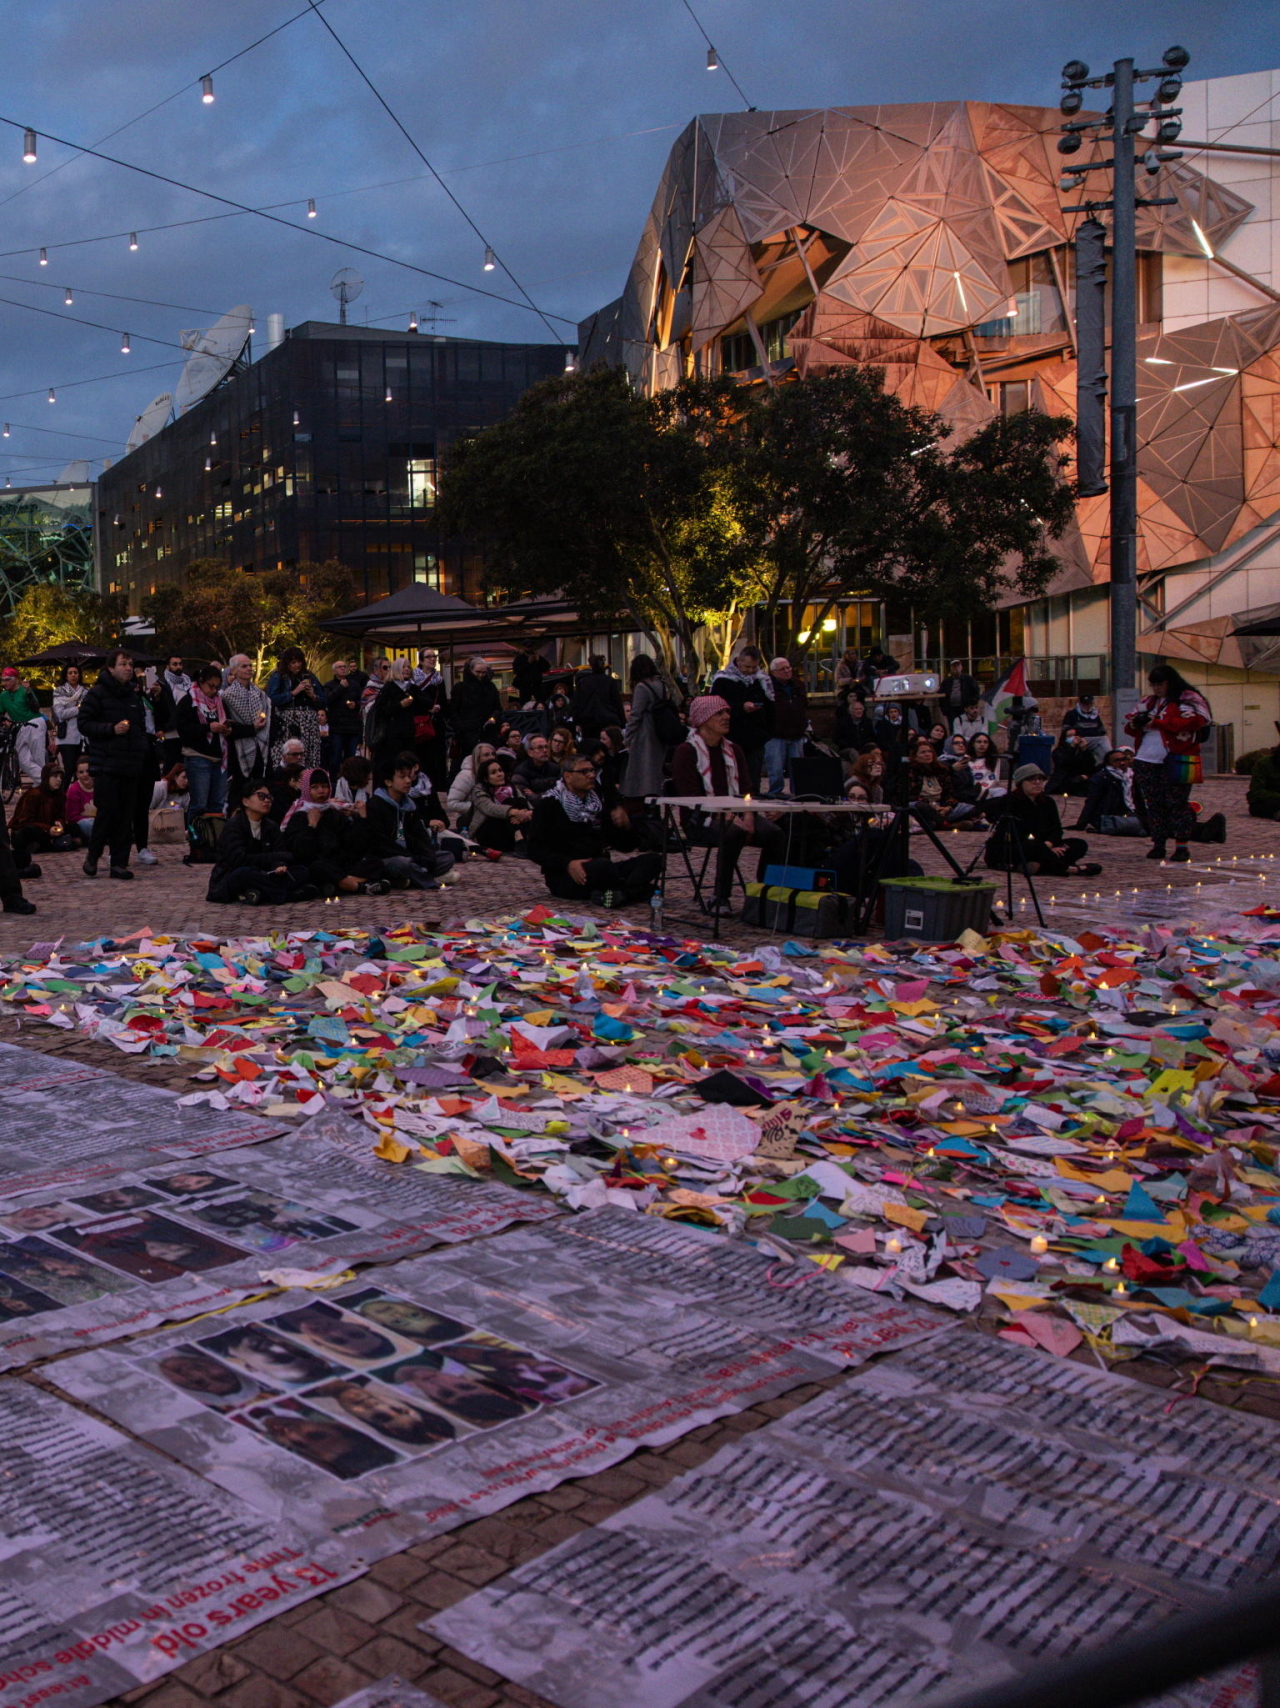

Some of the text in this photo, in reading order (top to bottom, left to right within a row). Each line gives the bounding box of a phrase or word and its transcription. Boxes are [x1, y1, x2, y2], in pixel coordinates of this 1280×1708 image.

[241, 1547, 304, 1577] Time
[149, 1562, 338, 1659] 13 years old
[165, 1571, 245, 1613] frozen
[140, 1602, 172, 1622] in
[54, 1617, 141, 1664] middle
[19, 1675, 92, 1708] At least
